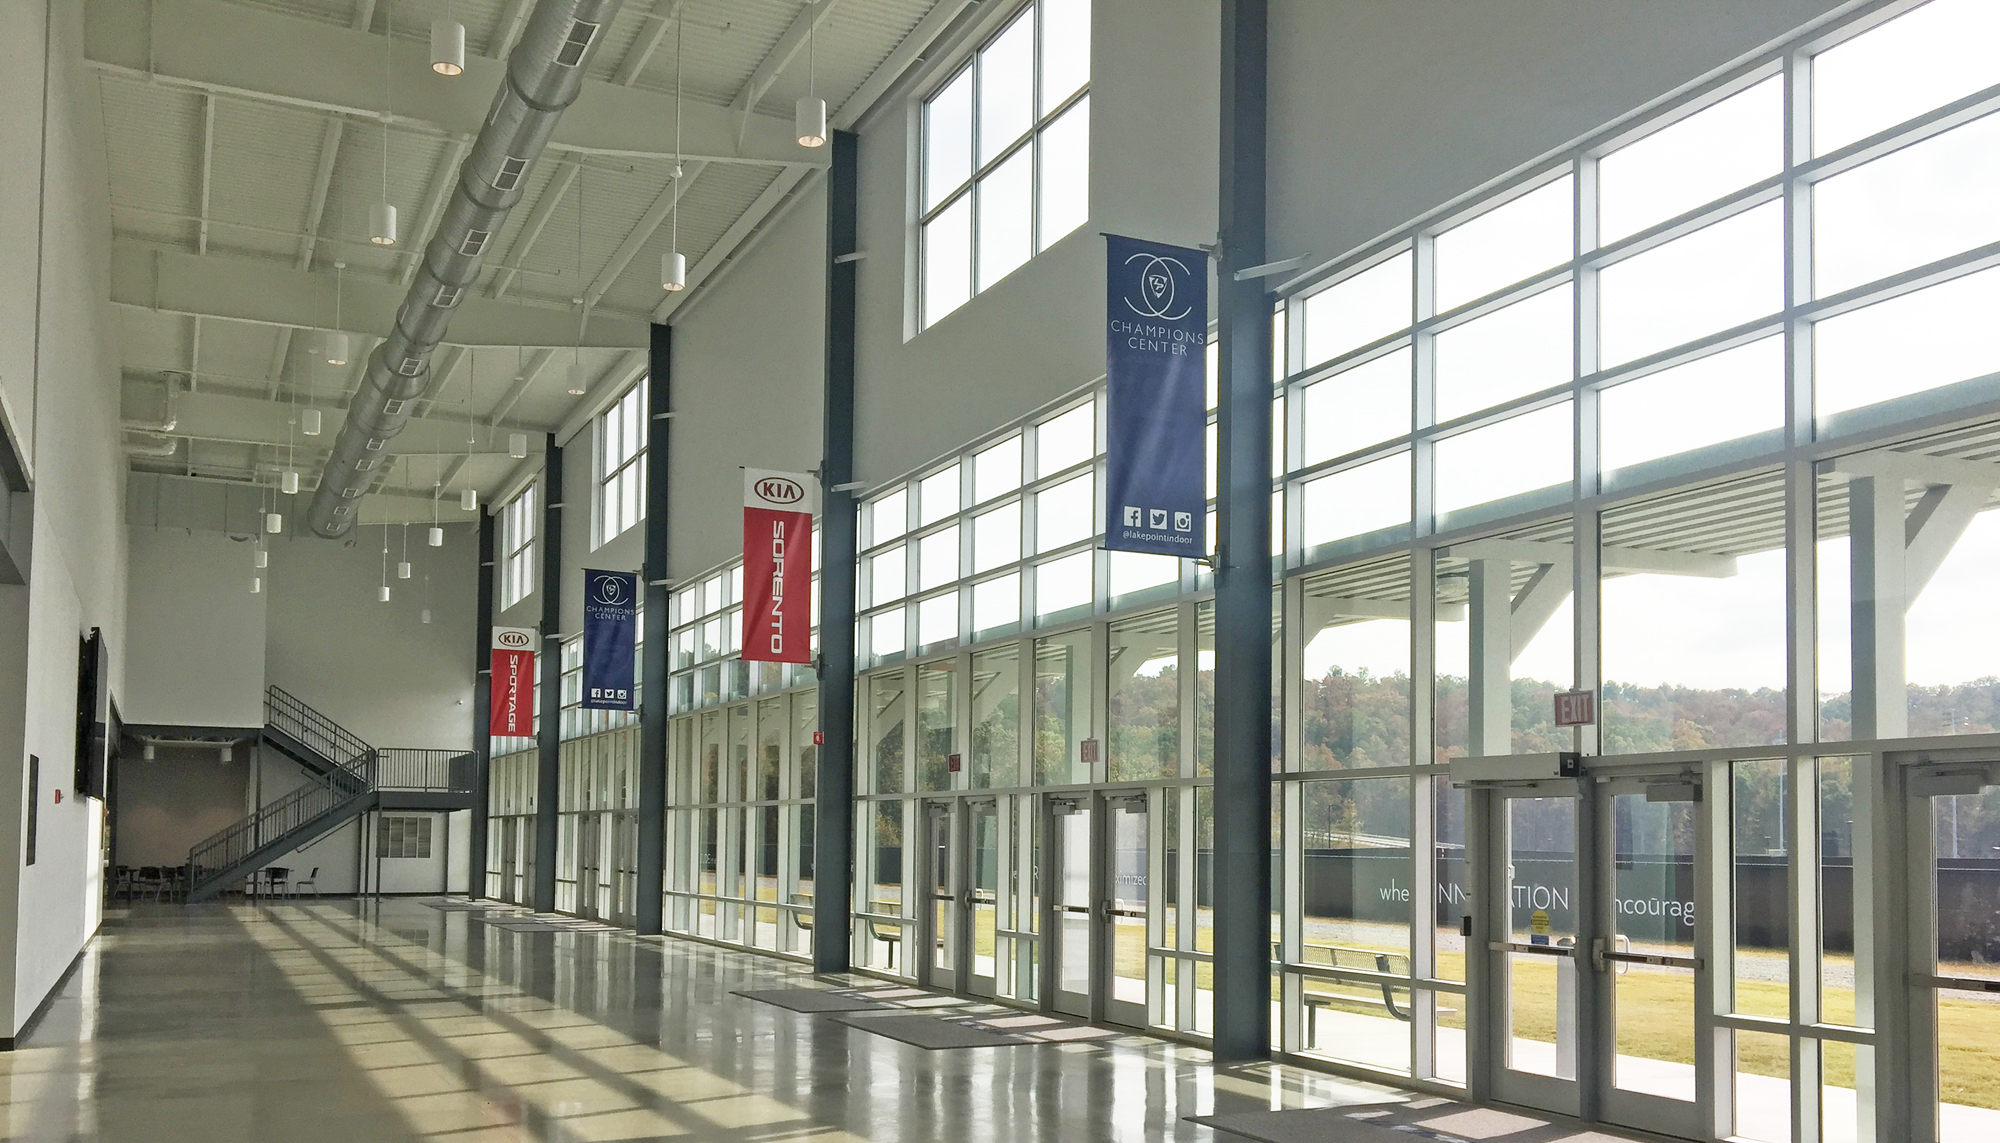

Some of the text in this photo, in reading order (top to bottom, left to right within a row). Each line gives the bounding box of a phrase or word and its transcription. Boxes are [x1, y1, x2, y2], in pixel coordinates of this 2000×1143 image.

[1111, 320, 1204, 345] CHAMPIONS
[1128, 337, 1188, 356] CENTER
[763, 482, 796, 500] KIA
[1123, 530, 1193, 544] @lakepointindoor
[770, 520, 785, 654] SORENTO
[586, 605, 635, 616] CHAMPIONS
[595, 612, 627, 621] CENTER
[504, 634, 524, 644] KIA
[507, 654, 519, 732] SPORTAGE
[1560, 694, 1589, 724] EXIT
[1115, 869, 1146, 886] ximize
[1615, 897, 1695, 926] ncourag
